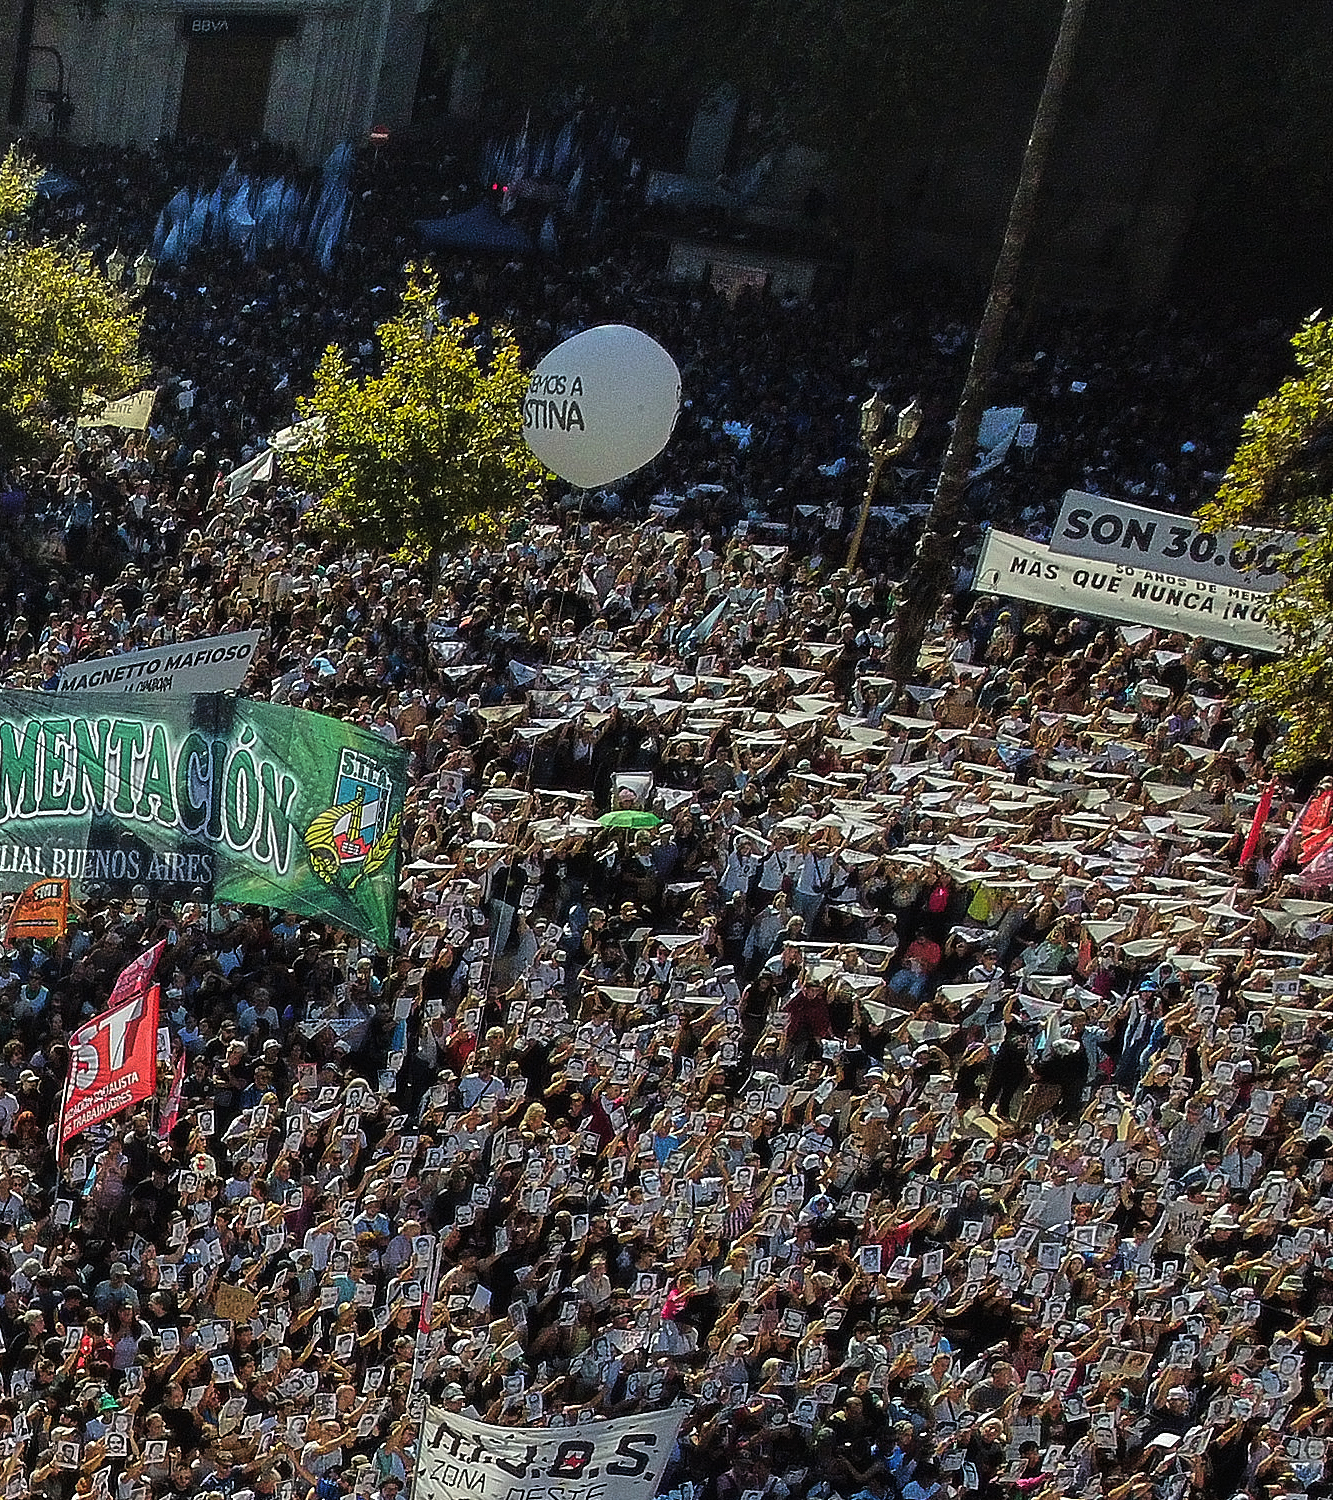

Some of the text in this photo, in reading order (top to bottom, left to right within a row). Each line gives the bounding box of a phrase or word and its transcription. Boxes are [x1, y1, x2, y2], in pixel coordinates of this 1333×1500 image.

[191, 19, 229, 33] BBVA
[1063, 509, 1158, 554] SON
[1070, 565, 1125, 596] QUE
[1129, 576, 1217, 614] NUNCA
[165, 643, 254, 676] MAFIOSO
[51, 848, 142, 879] BUENOS
[149, 852, 213, 884] AIRES
[430, 1456, 490, 1497] ZONA
